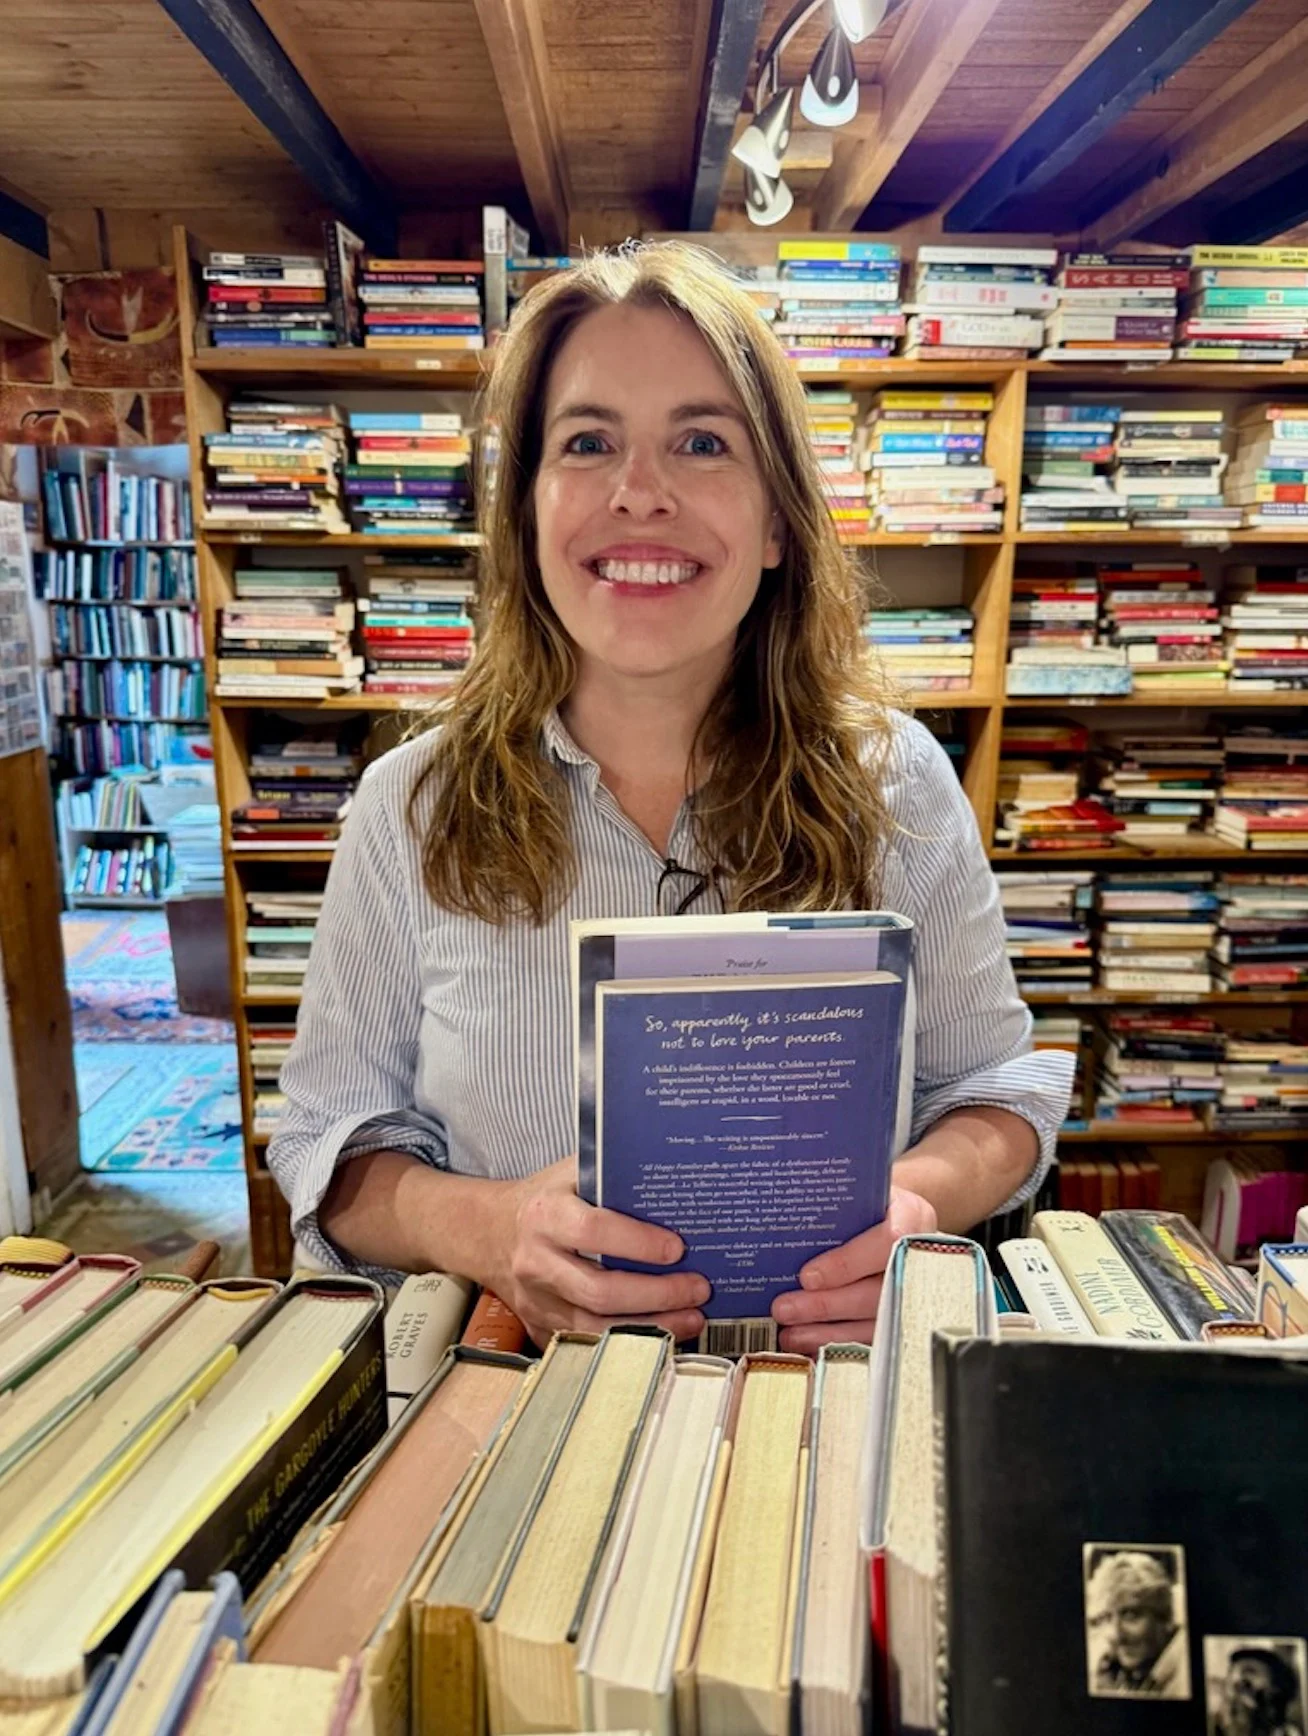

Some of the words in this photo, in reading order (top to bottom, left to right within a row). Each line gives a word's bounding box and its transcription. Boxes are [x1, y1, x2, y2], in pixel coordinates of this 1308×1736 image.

[725, 958, 752, 969] Praise
[753, 958, 768, 970] for
[645, 1014, 668, 1033] So,
[671, 1012, 751, 1033] apparently
[756, 1010, 780, 1026] it's
[784, 1006, 865, 1025] scandalous
[661, 1035, 685, 1051] not
[691, 1034, 705, 1049] to
[710, 1032, 738, 1048] love
[742, 1034, 780, 1051] your
[1097, 1257, 1164, 1330] GORDIMER
[387, 1312, 413, 1358] ROBERT
[400, 1311, 429, 1359] GRAVES
[245, 1499, 270, 1532] THE
[273, 1417, 335, 1496] GARGOYLE
